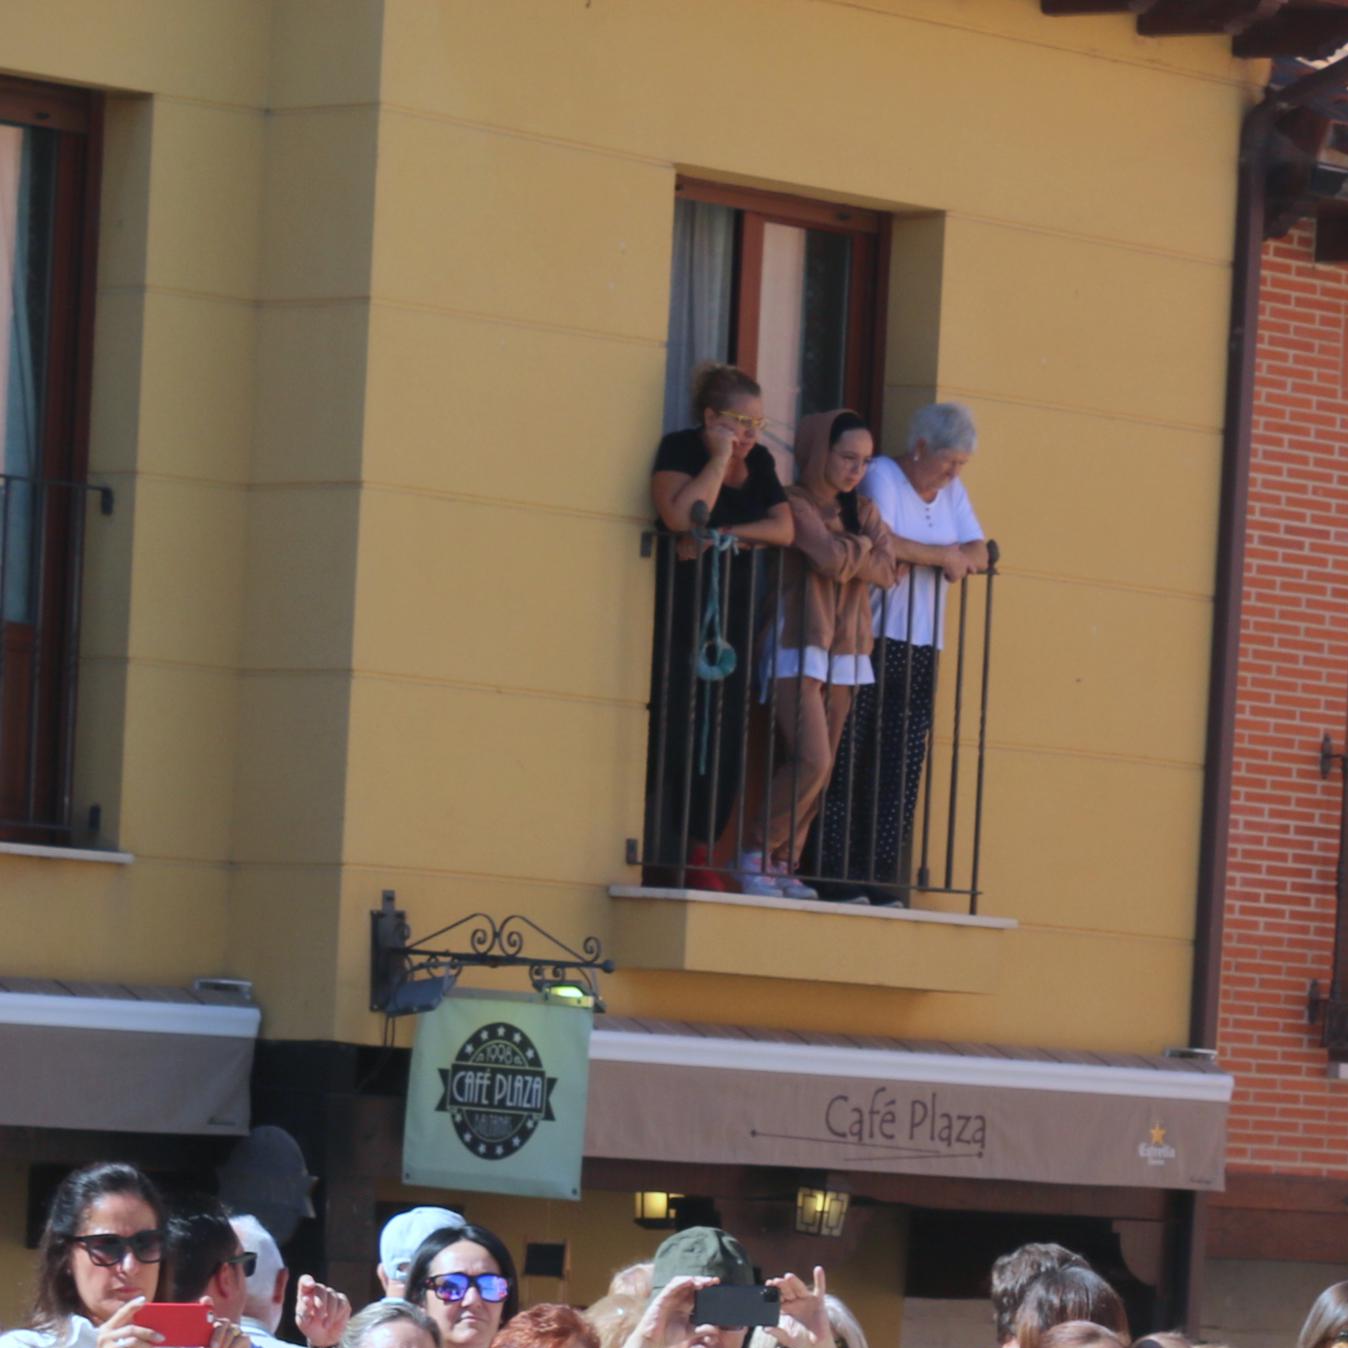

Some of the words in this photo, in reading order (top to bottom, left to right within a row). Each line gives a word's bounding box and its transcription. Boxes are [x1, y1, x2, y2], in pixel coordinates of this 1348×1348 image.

[452, 1068, 492, 1105] CAFÉ
[494, 1073, 542, 1109] PLAZA
[825, 1086, 896, 1143] Café
[909, 1092, 987, 1149] Plaza
